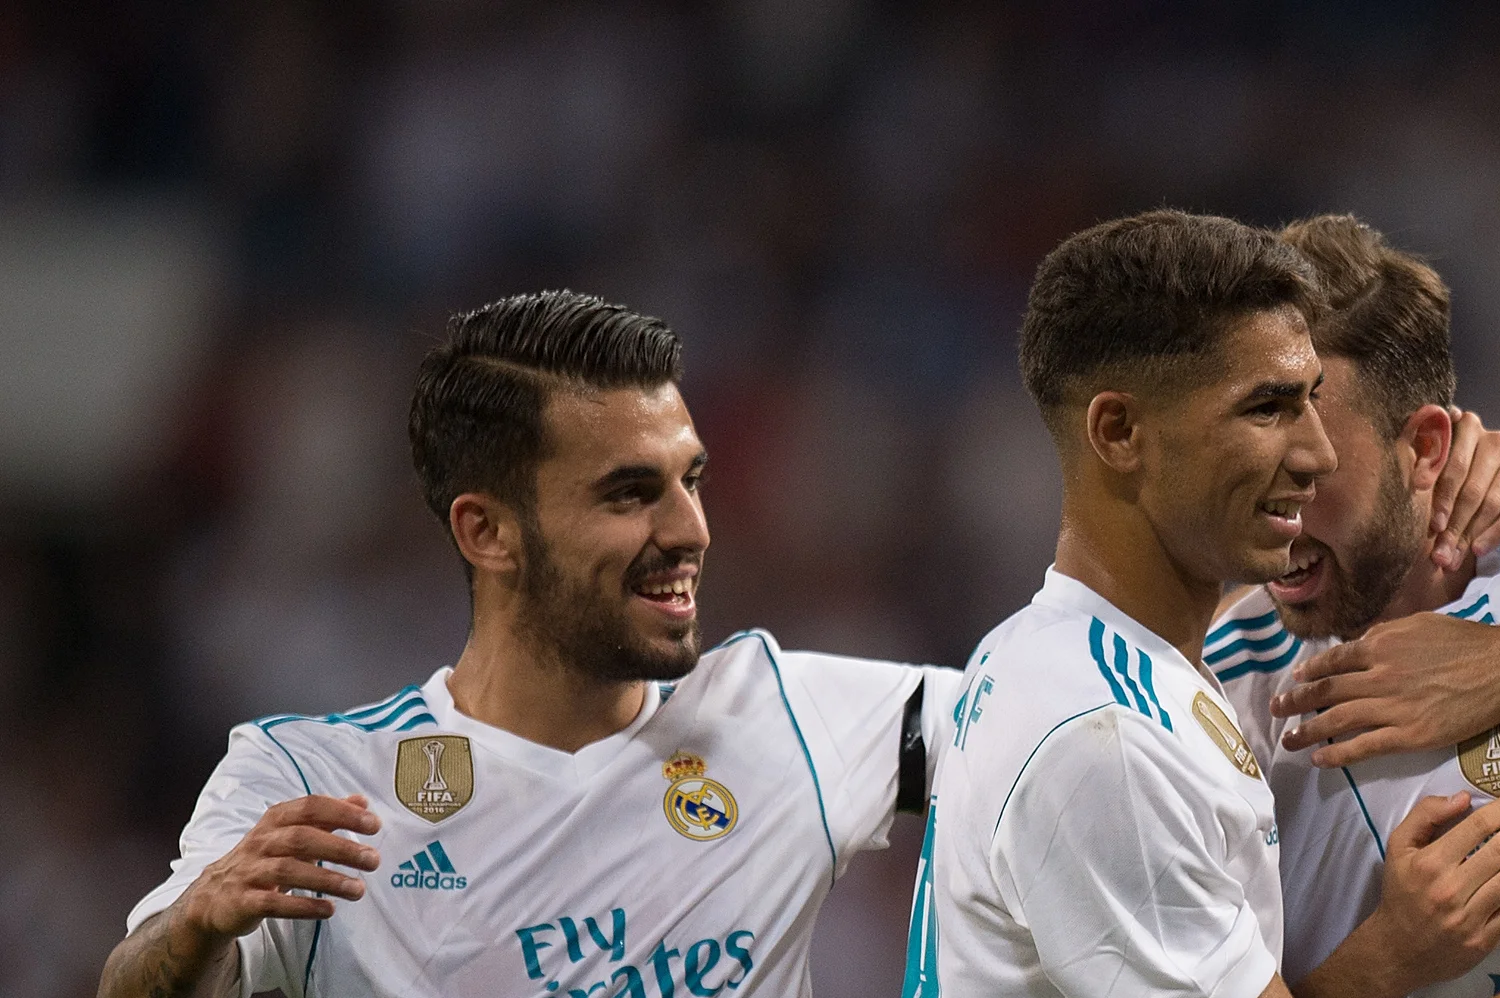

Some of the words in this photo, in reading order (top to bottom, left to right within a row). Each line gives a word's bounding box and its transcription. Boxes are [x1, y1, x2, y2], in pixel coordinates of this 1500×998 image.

[417, 791, 453, 802] FIFA
[390, 870, 468, 891] adidas
[516, 907, 627, 980] Fly
